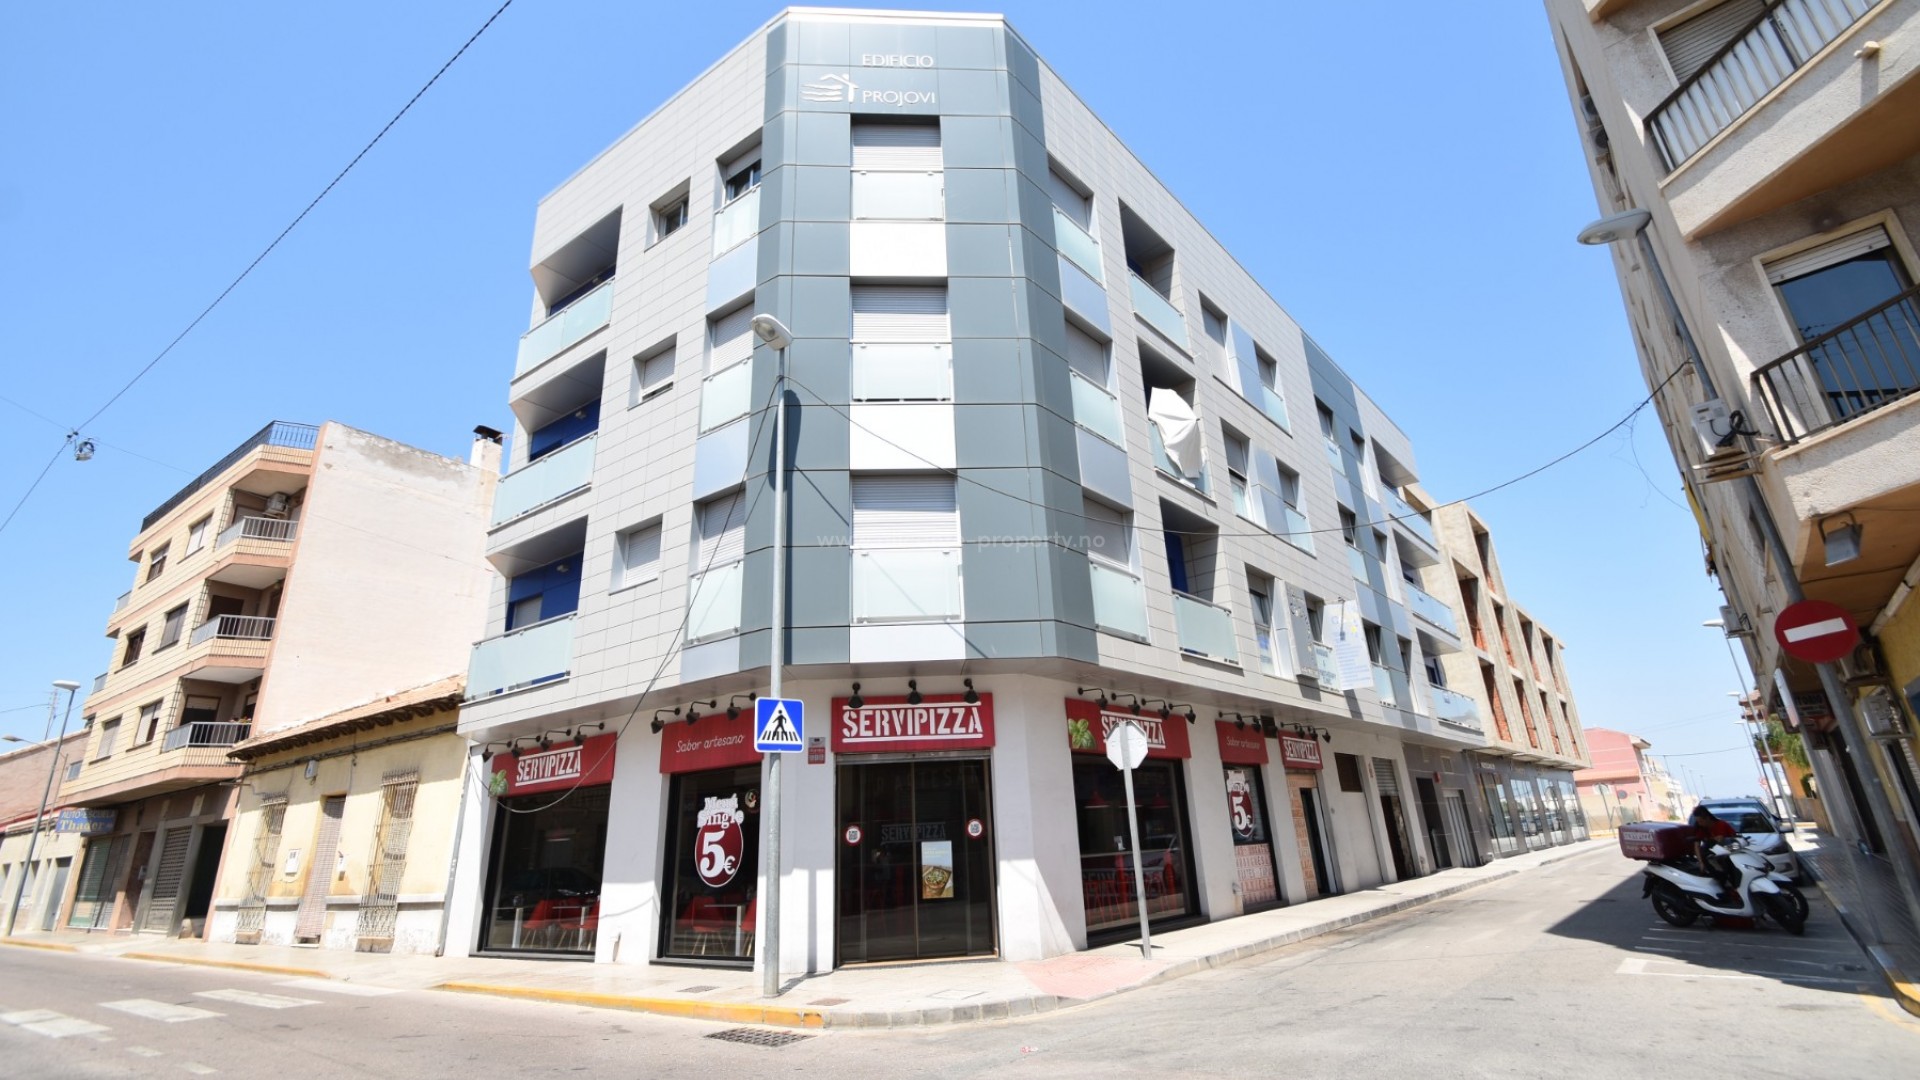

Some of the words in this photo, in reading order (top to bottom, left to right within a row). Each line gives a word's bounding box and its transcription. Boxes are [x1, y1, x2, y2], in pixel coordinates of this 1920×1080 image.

[862, 54, 934, 68] EDIFICIO
[862, 90, 936, 107] PROJOVI
[842, 706, 983, 738] SERVIPIZZA
[676, 740, 701, 753] Sabor
[703, 734, 744, 749] artesano
[1283, 740, 1320, 760] SERVIPIZZA
[516, 750, 581, 782] SERVIPIZZA
[700, 830, 736, 878] 5€
